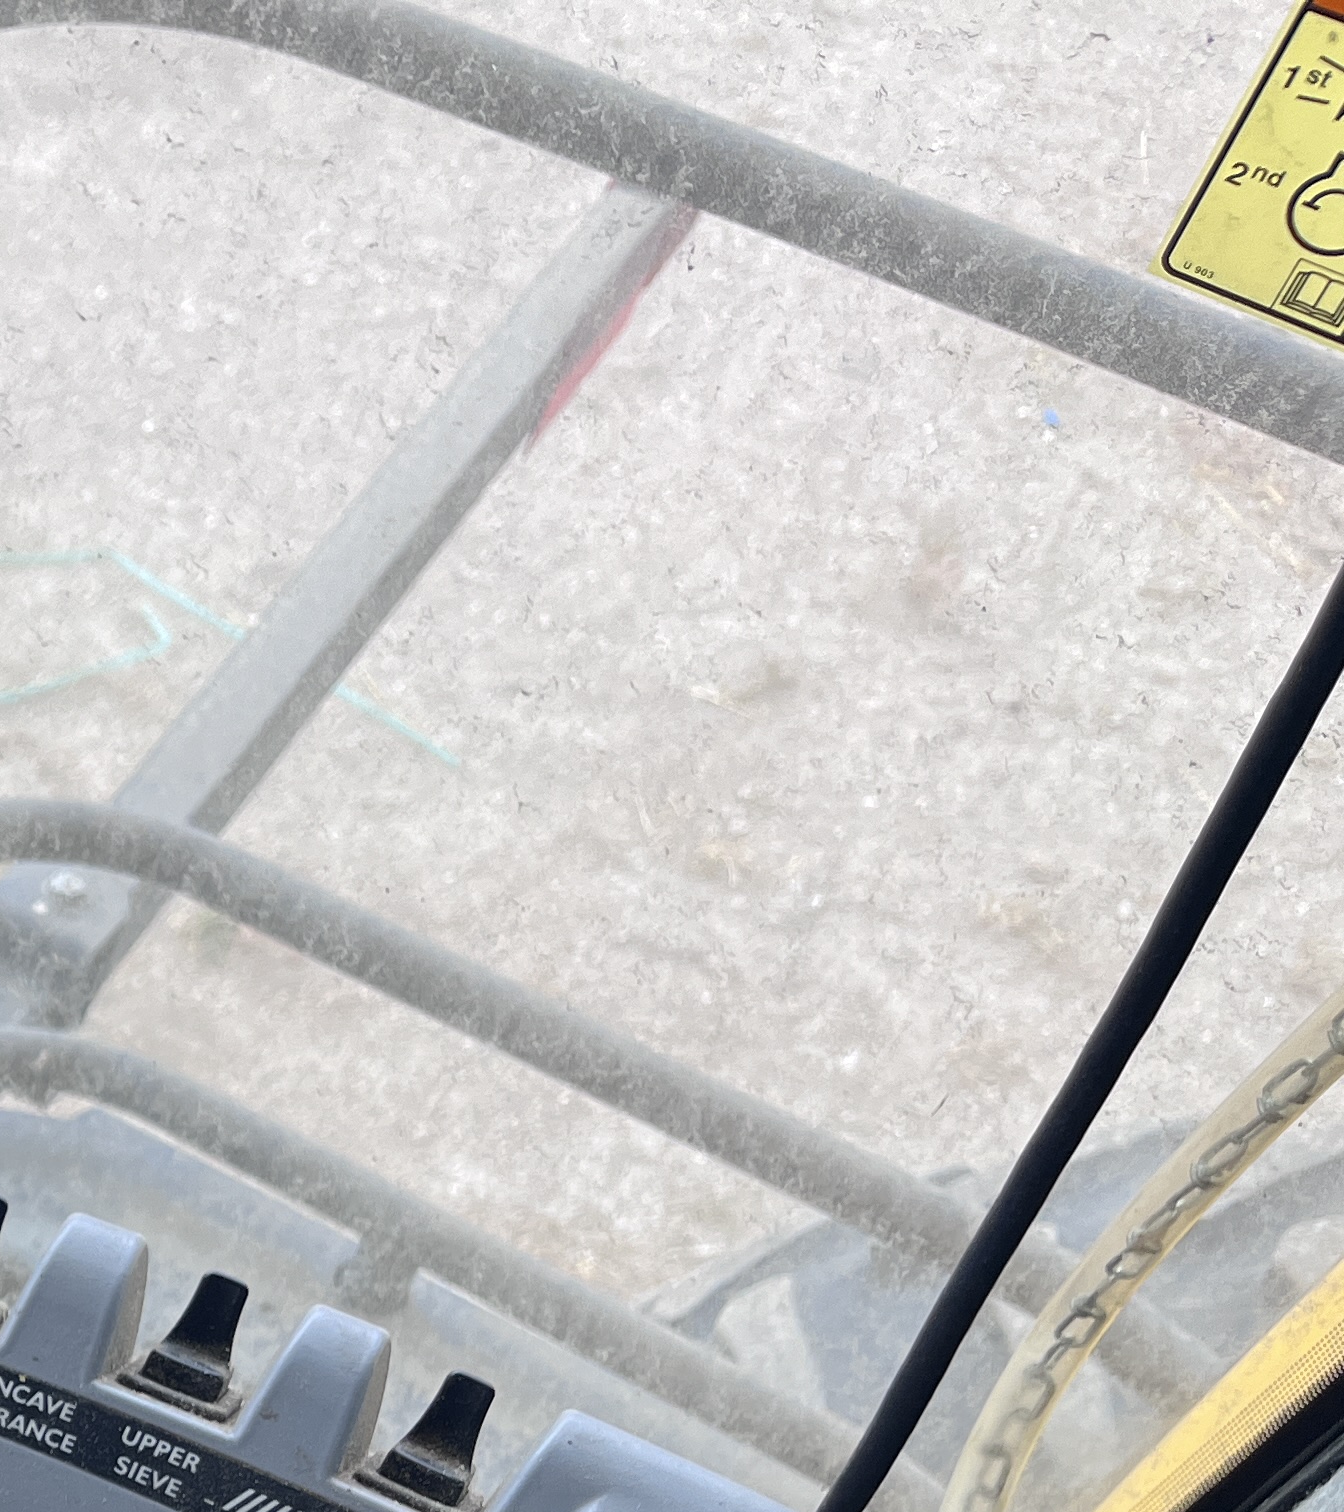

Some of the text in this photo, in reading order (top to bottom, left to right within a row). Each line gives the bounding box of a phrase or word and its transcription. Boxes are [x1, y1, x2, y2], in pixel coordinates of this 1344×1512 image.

[1225, 161, 1288, 189] 2nd
[1194, 265, 1215, 280] 903
[121, 1424, 202, 1474] UPPER
[113, 1454, 184, 1500] SIEVE
